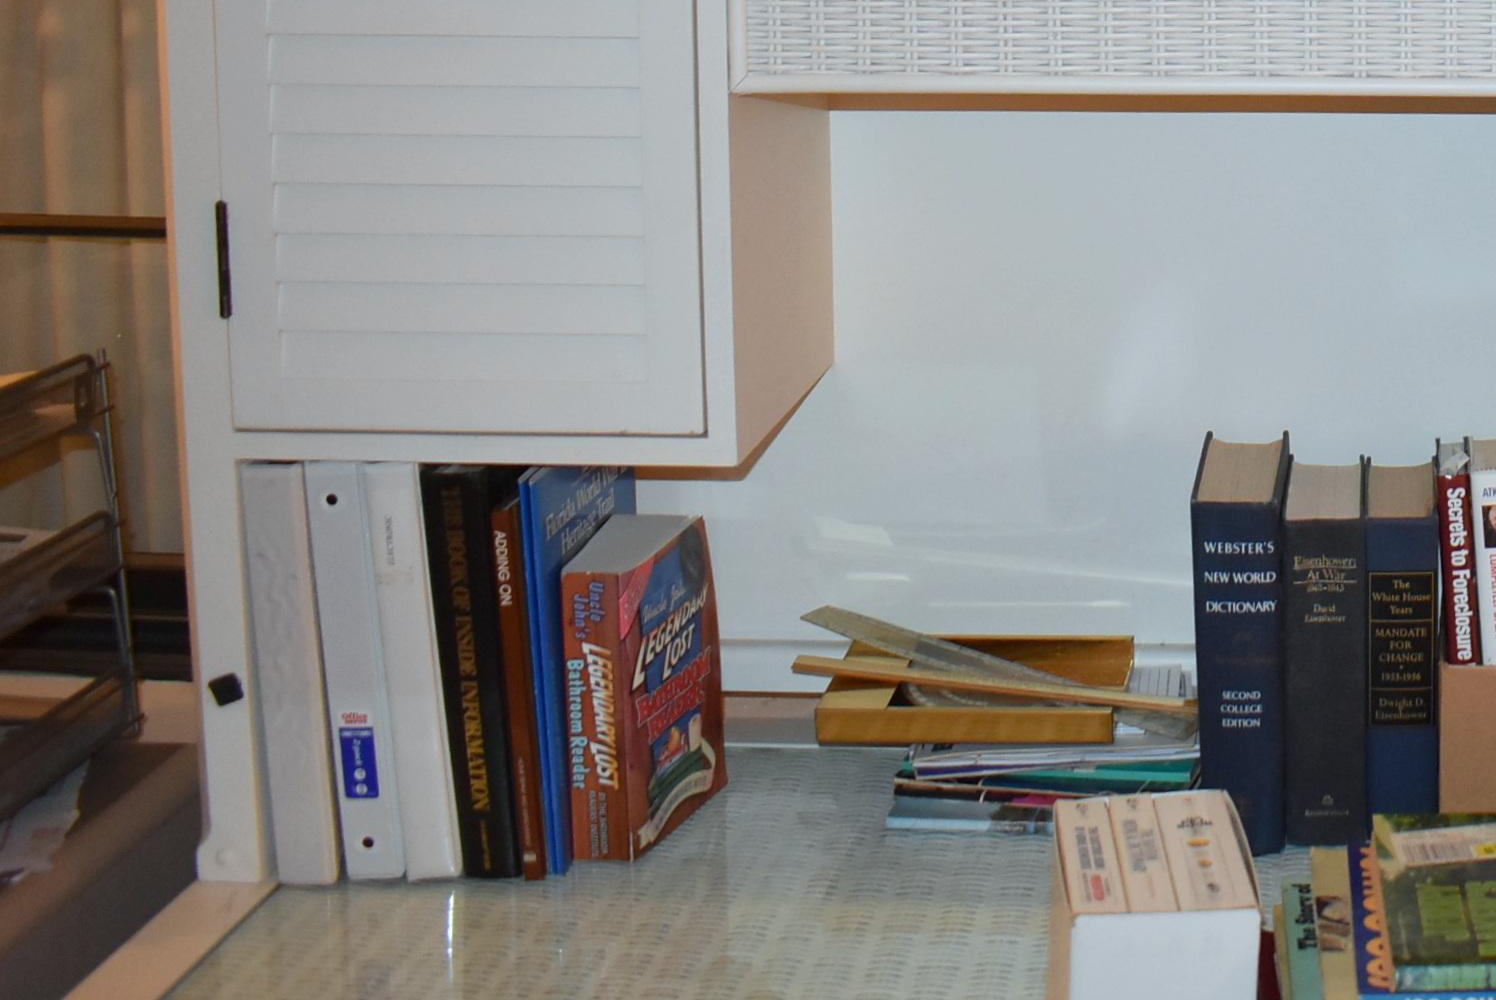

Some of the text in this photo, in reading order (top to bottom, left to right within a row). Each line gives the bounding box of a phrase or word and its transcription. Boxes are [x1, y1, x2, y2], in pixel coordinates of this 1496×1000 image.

[545, 498, 577, 540] Florida
[1204, 540, 1275, 554] WEBSTER'S
[446, 530, 470, 586] BOOK
[493, 530, 512, 606] ADDING ON
[1323, 568, 1348, 581] War
[1446, 487, 1474, 660] Secrets to Foreclosure
[1204, 571, 1277, 584] NEW WORLD
[1392, 579, 1410, 590] The
[453, 587, 471, 612] OF
[589, 581, 606, 622] Uncle
[1371, 591, 1432, 602] White House
[1206, 600, 1278, 614] DICTIONARY
[1313, 603, 1336, 614] David
[1390, 605, 1413, 615] Years
[574, 594, 591, 639] John's
[632, 584, 709, 692] LEGENDARY
[1375, 627, 1428, 638] MANDATE
[455, 615, 477, 676] INSIDE
[1390, 640, 1413, 650] FOR
[662, 624, 696, 682] LOST
[1378, 652, 1424, 663] CHANGE
[1222, 690, 1261, 700] SECOND
[1220, 704, 1263, 714] COLLEGE
[1379, 697, 1412, 711] Dwight
[582, 642, 619, 791] LEGENDARY LOST
[1375, 709, 1428, 720] Eisenhower
[567, 659, 590, 789] Bathroom Reader
[1222, 718, 1261, 728] EDITION
[461, 680, 491, 812] INFORMATION
